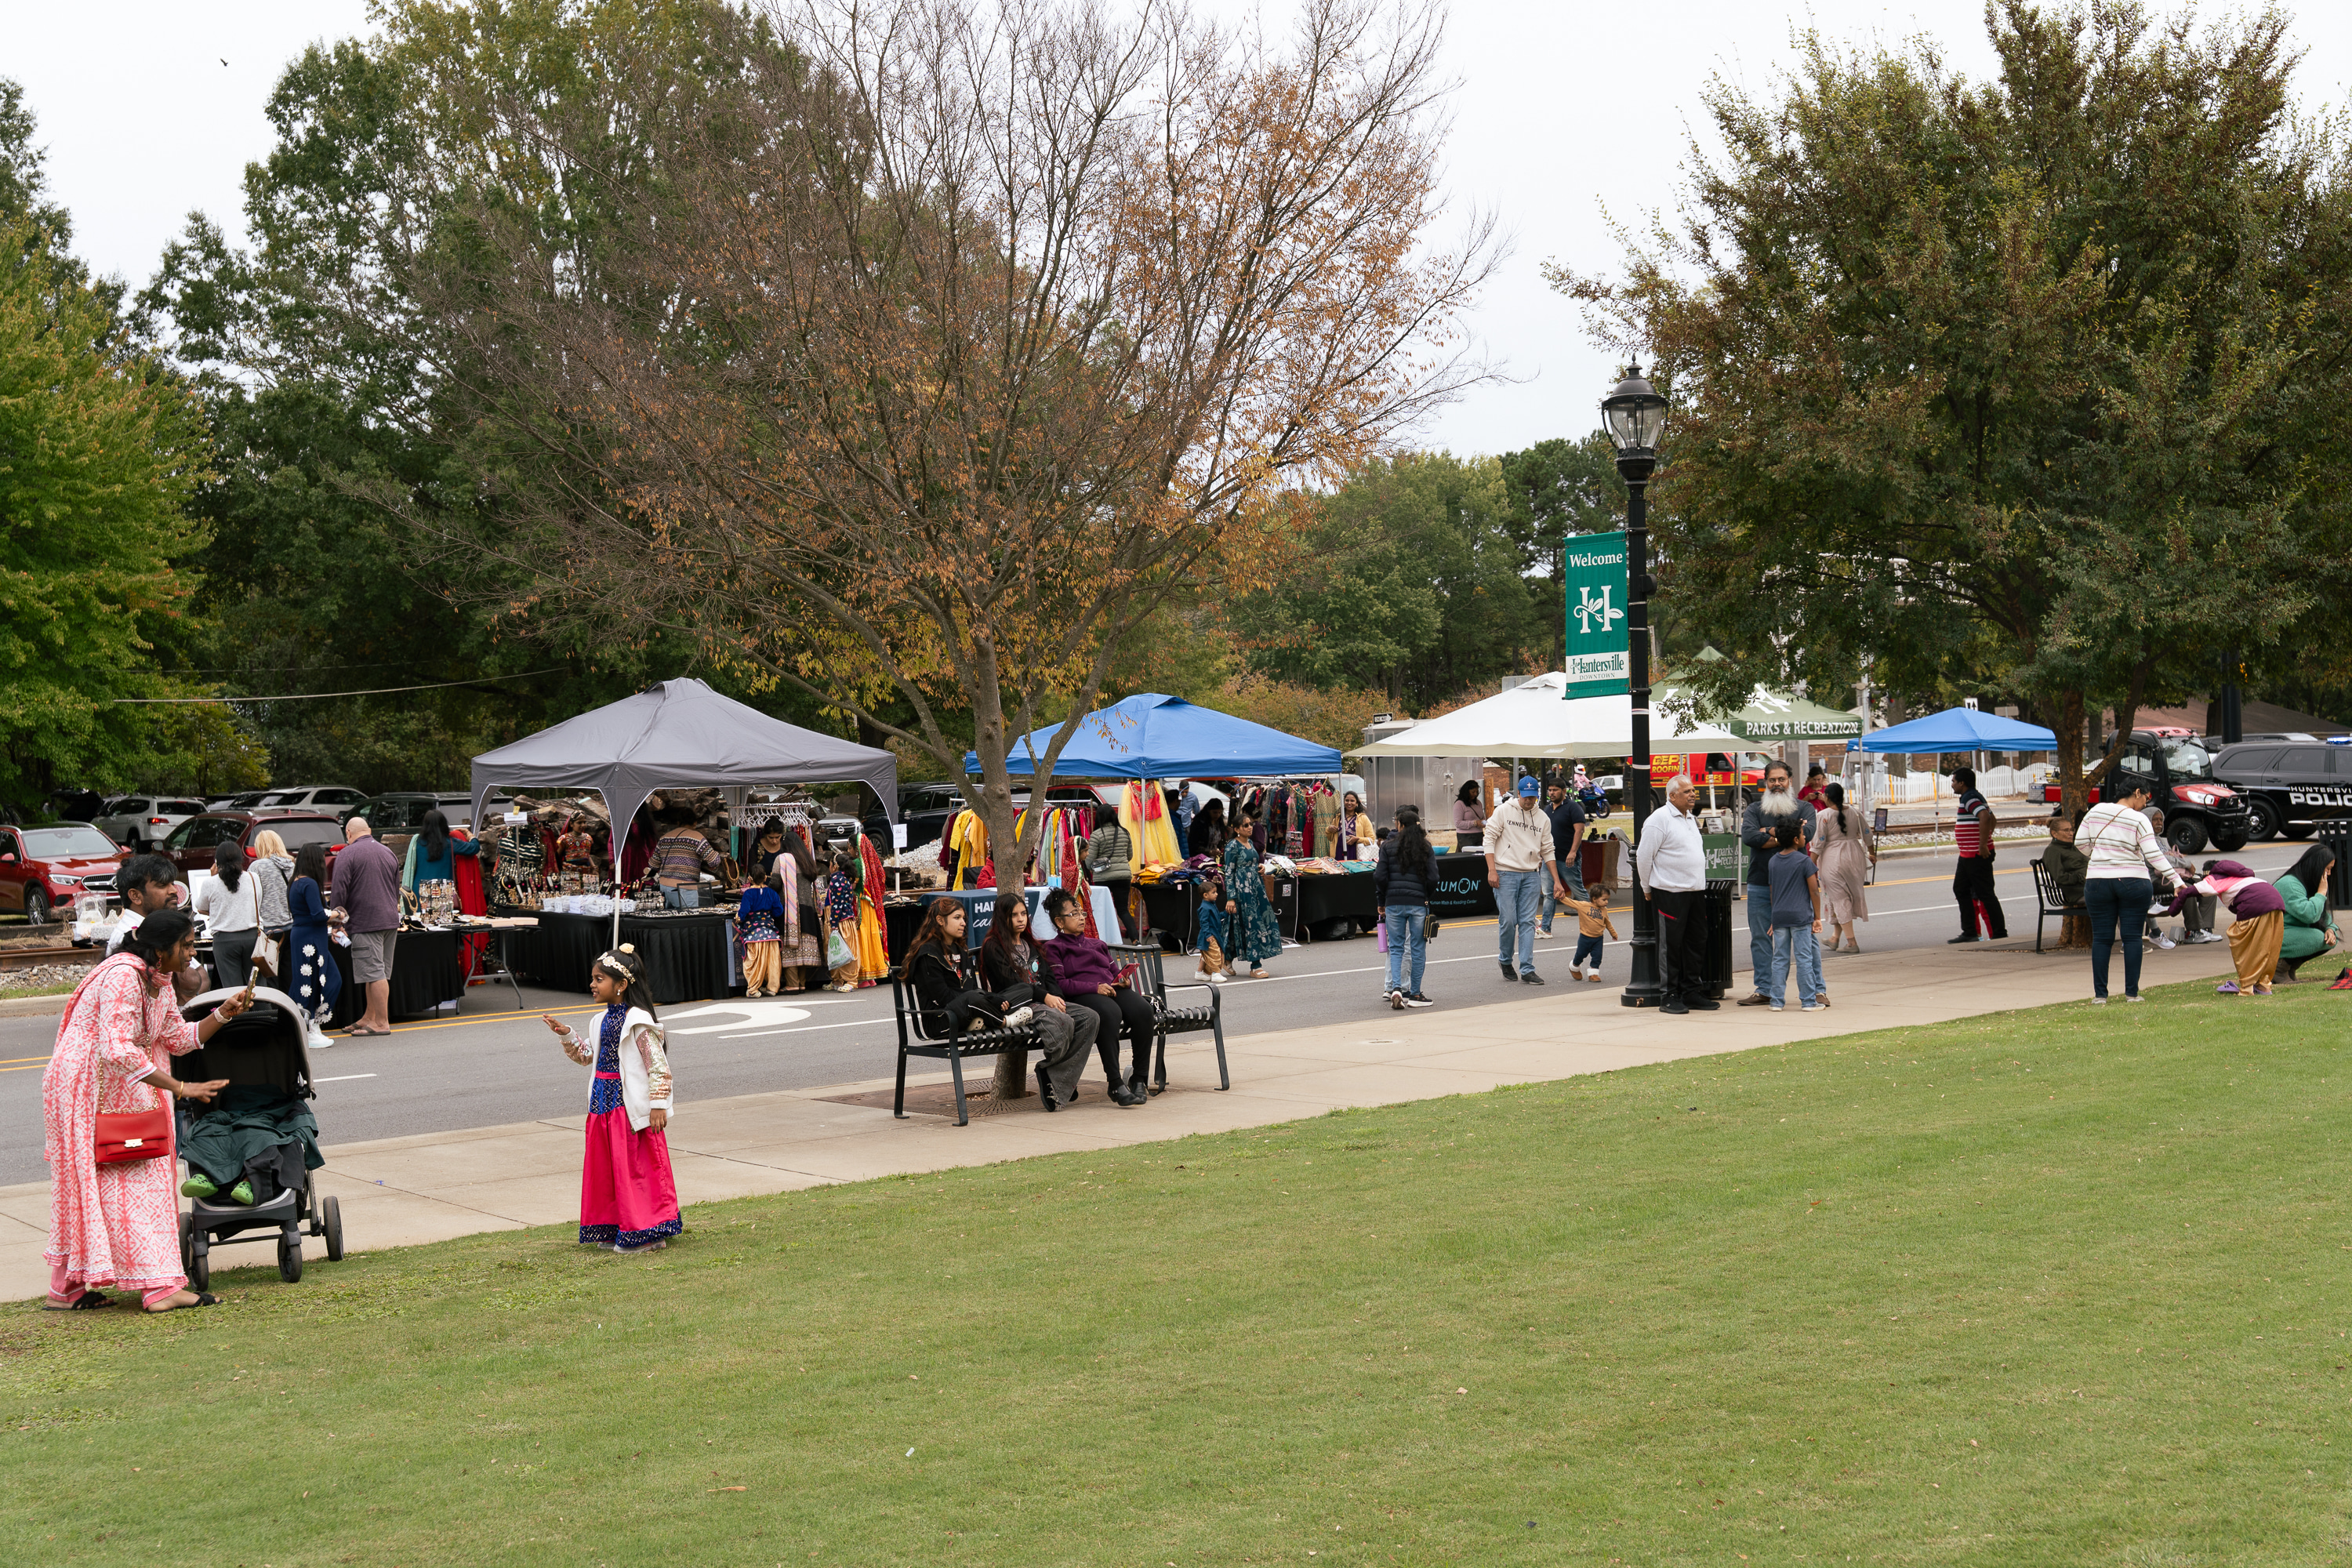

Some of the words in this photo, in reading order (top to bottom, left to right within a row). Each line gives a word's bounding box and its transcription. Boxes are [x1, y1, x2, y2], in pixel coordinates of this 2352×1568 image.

[1569, 553, 1623, 568] Welcome
[1570, 654, 1624, 674] Huntersville
[1746, 721, 1780, 735] PARKS
[1783, 722, 1791, 735] &
[1794, 720, 1858, 735] RECREATION
